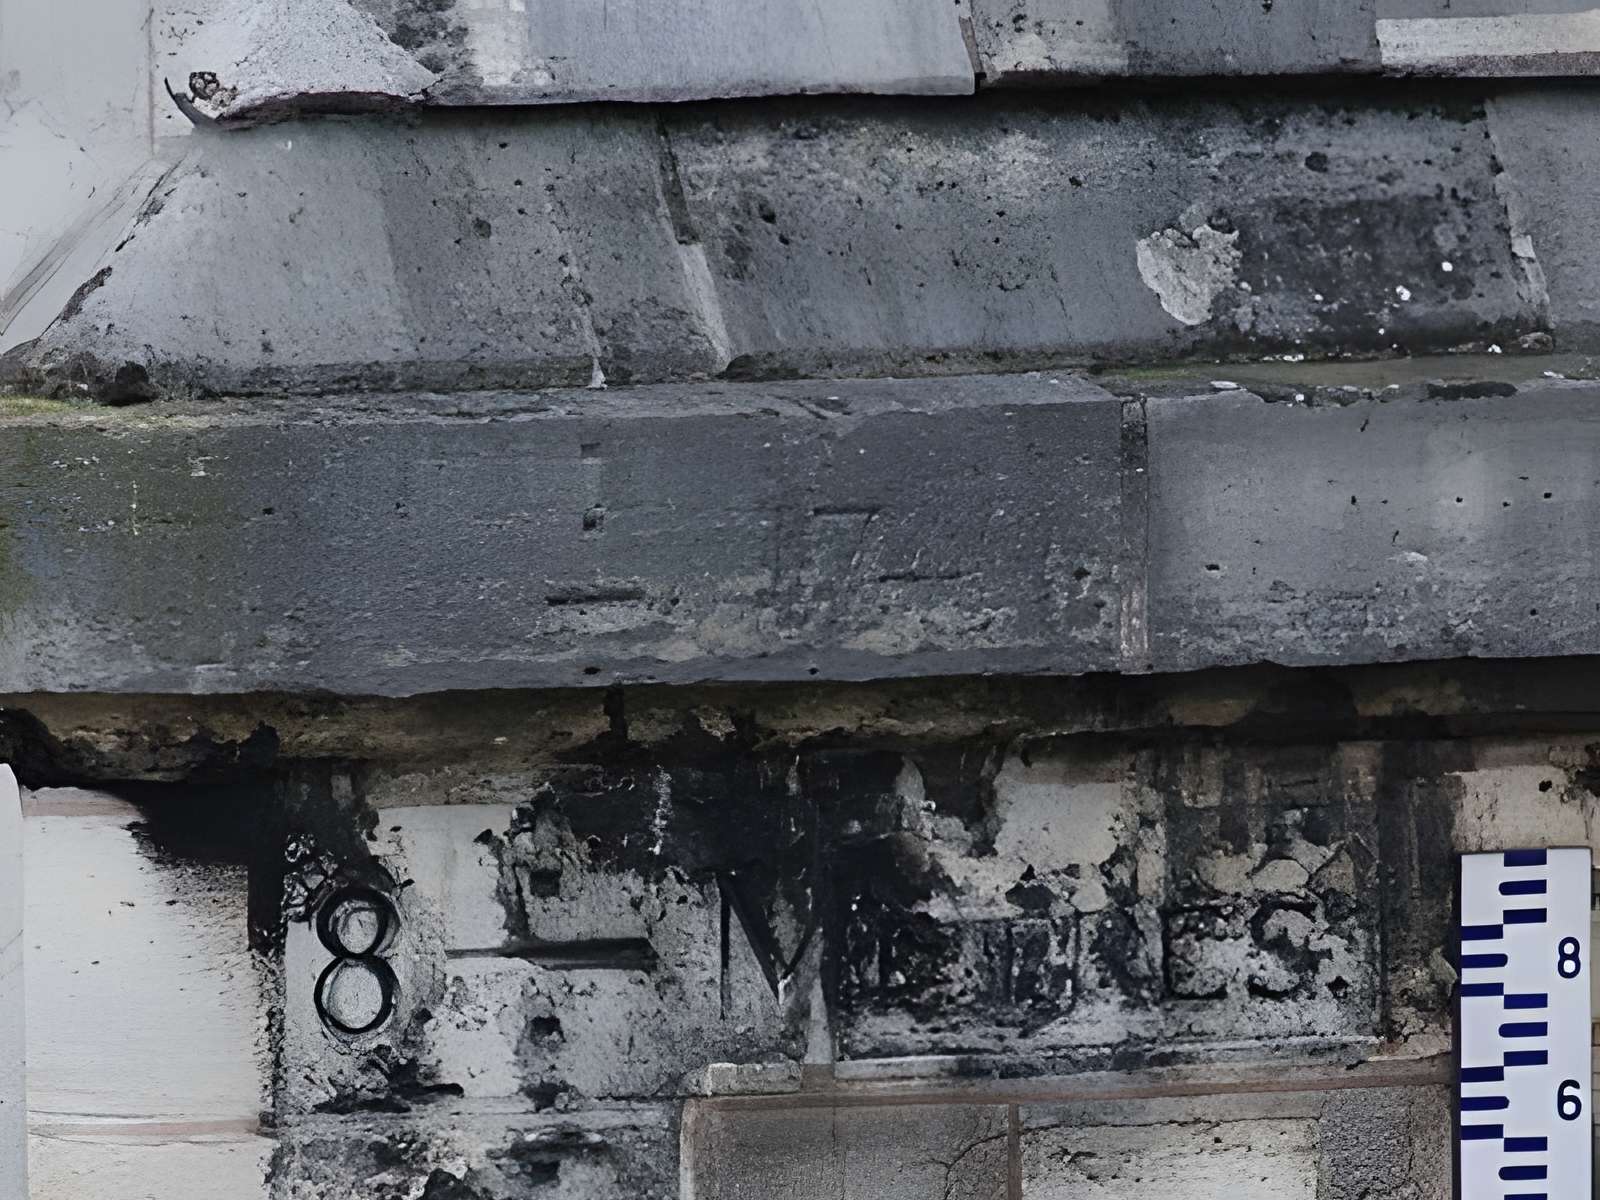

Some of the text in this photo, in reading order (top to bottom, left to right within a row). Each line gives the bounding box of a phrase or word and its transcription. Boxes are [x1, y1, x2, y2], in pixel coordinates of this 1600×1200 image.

[314, 884, 401, 1035] 8
[1556, 936, 1581, 979] 8
[1556, 1079, 1582, 1121] 6
